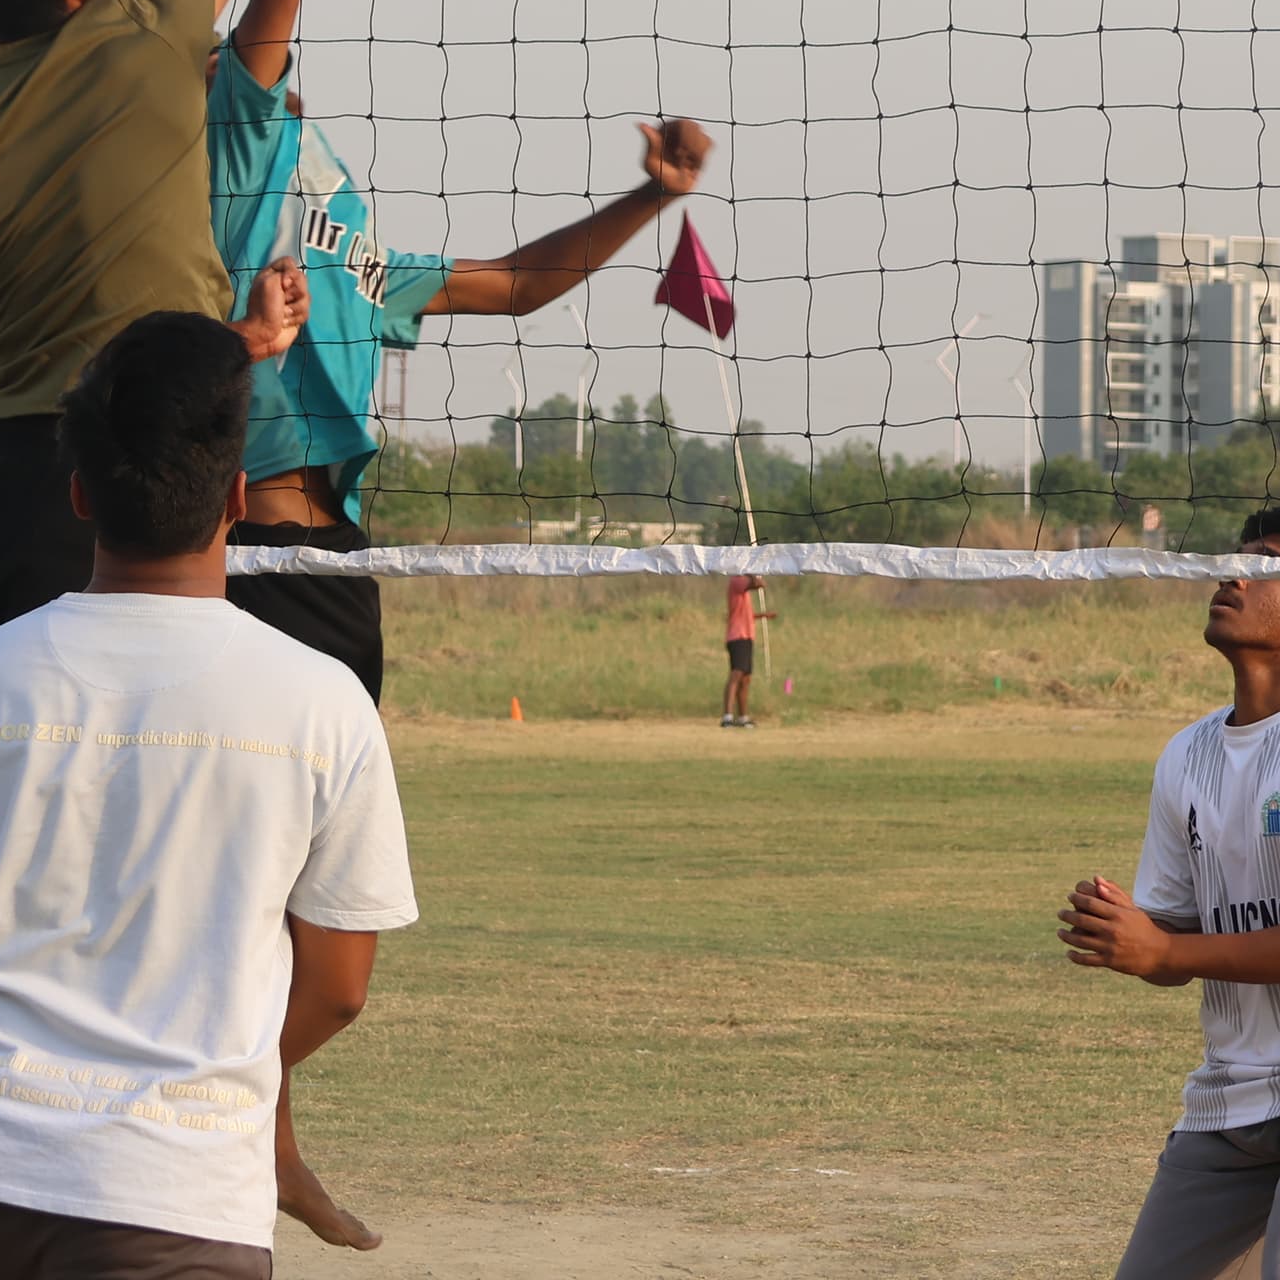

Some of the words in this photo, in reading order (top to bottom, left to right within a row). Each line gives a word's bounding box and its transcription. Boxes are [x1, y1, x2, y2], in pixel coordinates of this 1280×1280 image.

[35, 723, 83, 743] ZEN
[161, 1080, 234, 1105] uncover
[11, 1085, 82, 1111] essence
[86, 1095, 108, 1113] of
[177, 1111, 217, 1131] and
